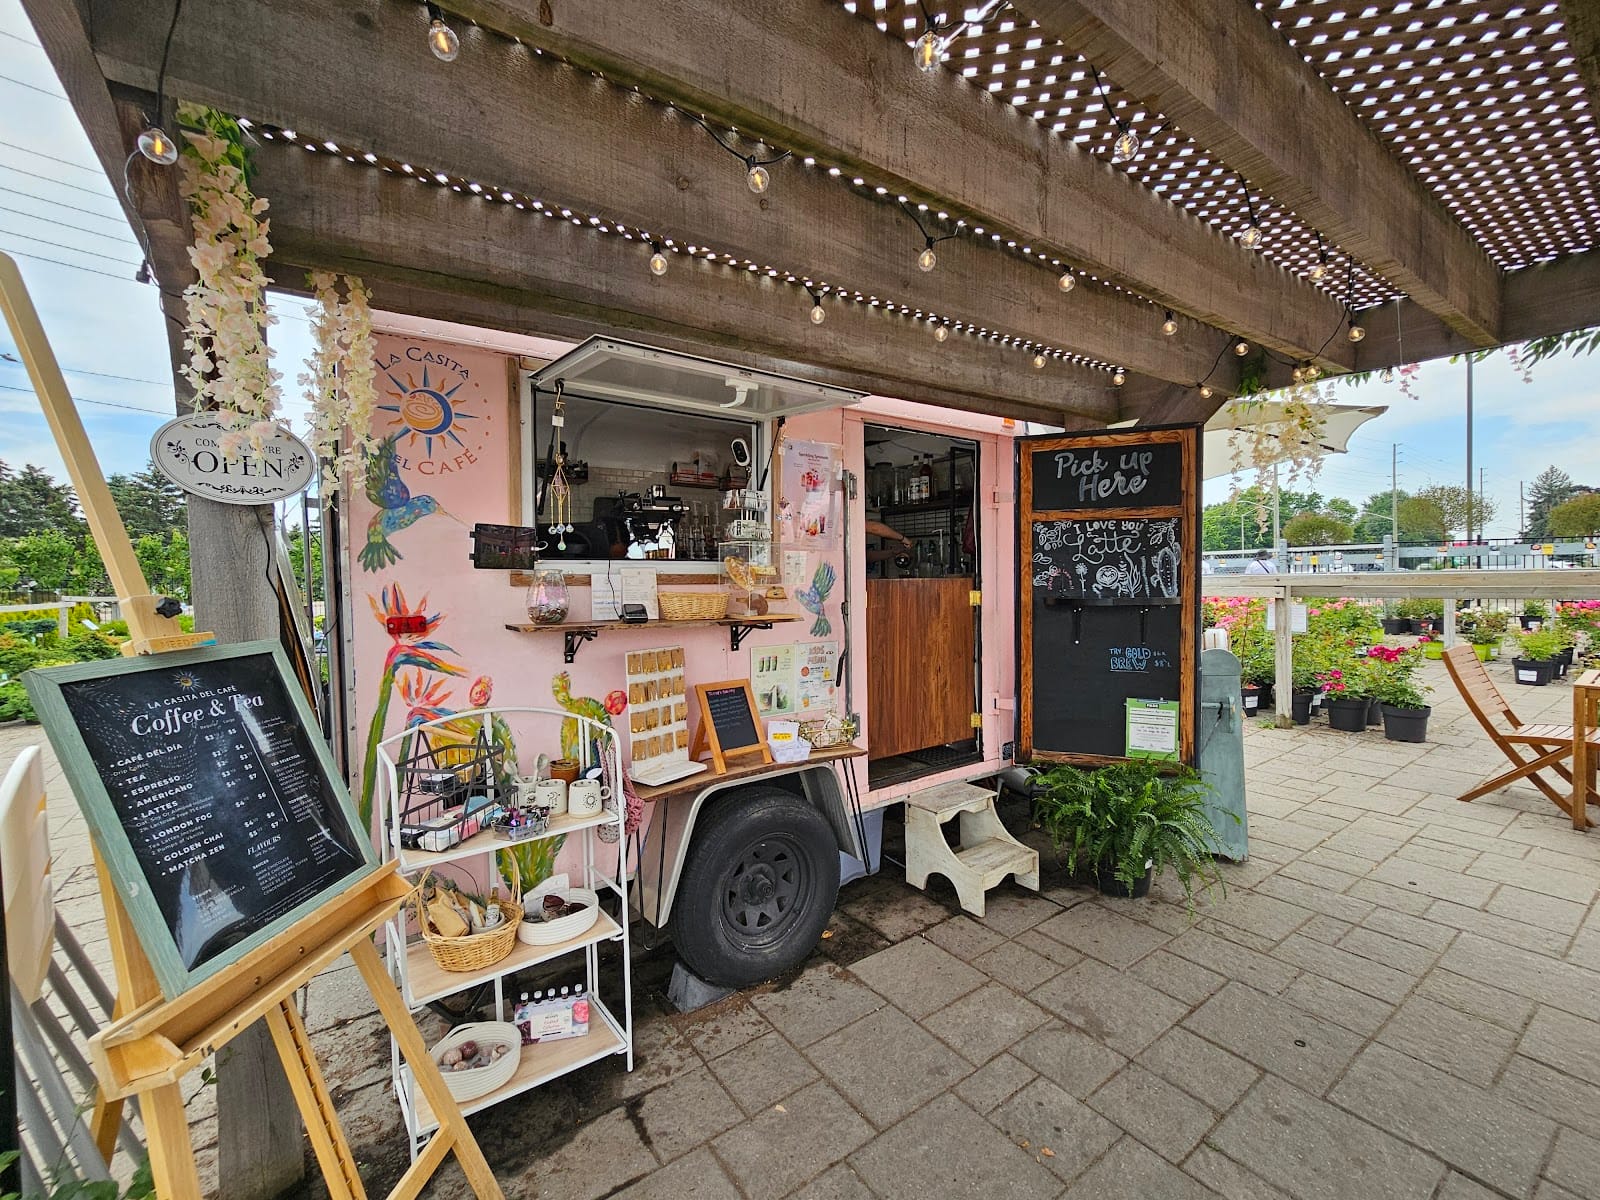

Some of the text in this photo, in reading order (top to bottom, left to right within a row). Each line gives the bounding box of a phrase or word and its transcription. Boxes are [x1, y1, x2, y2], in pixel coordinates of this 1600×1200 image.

[374, 346, 470, 381] LA CASITA
[191, 450, 283, 479] OPEN
[1054, 450, 1109, 479] Pick
[1079, 471, 1148, 502] Here
[1073, 520, 1145, 535] I LOVE YOU
[1063, 530, 1142, 565] Latte
[1110, 656, 1147, 670] BREW
[147, 701, 161, 710] LA
[163, 694, 198, 706] CASITA
[199, 690, 216, 699] DEL
[131, 693, 265, 736] Coffee & Tea
[146, 748, 166, 758] DEL
[126, 774, 146, 784] TEA
[131, 775, 180, 796] ESPRESSO
[137, 783, 193, 807] AMERICANO
[140, 800, 179, 819] LATTES
[152, 820, 194, 841] LONDON
[195, 812, 213, 823] FOG
[164, 841, 202, 862] GOLDEN
[203, 832, 224, 845] CHAI
[247, 833, 282, 855] FLAVOURS
[168, 852, 208, 873] MATCHA
[208, 844, 225, 855] ZEN
